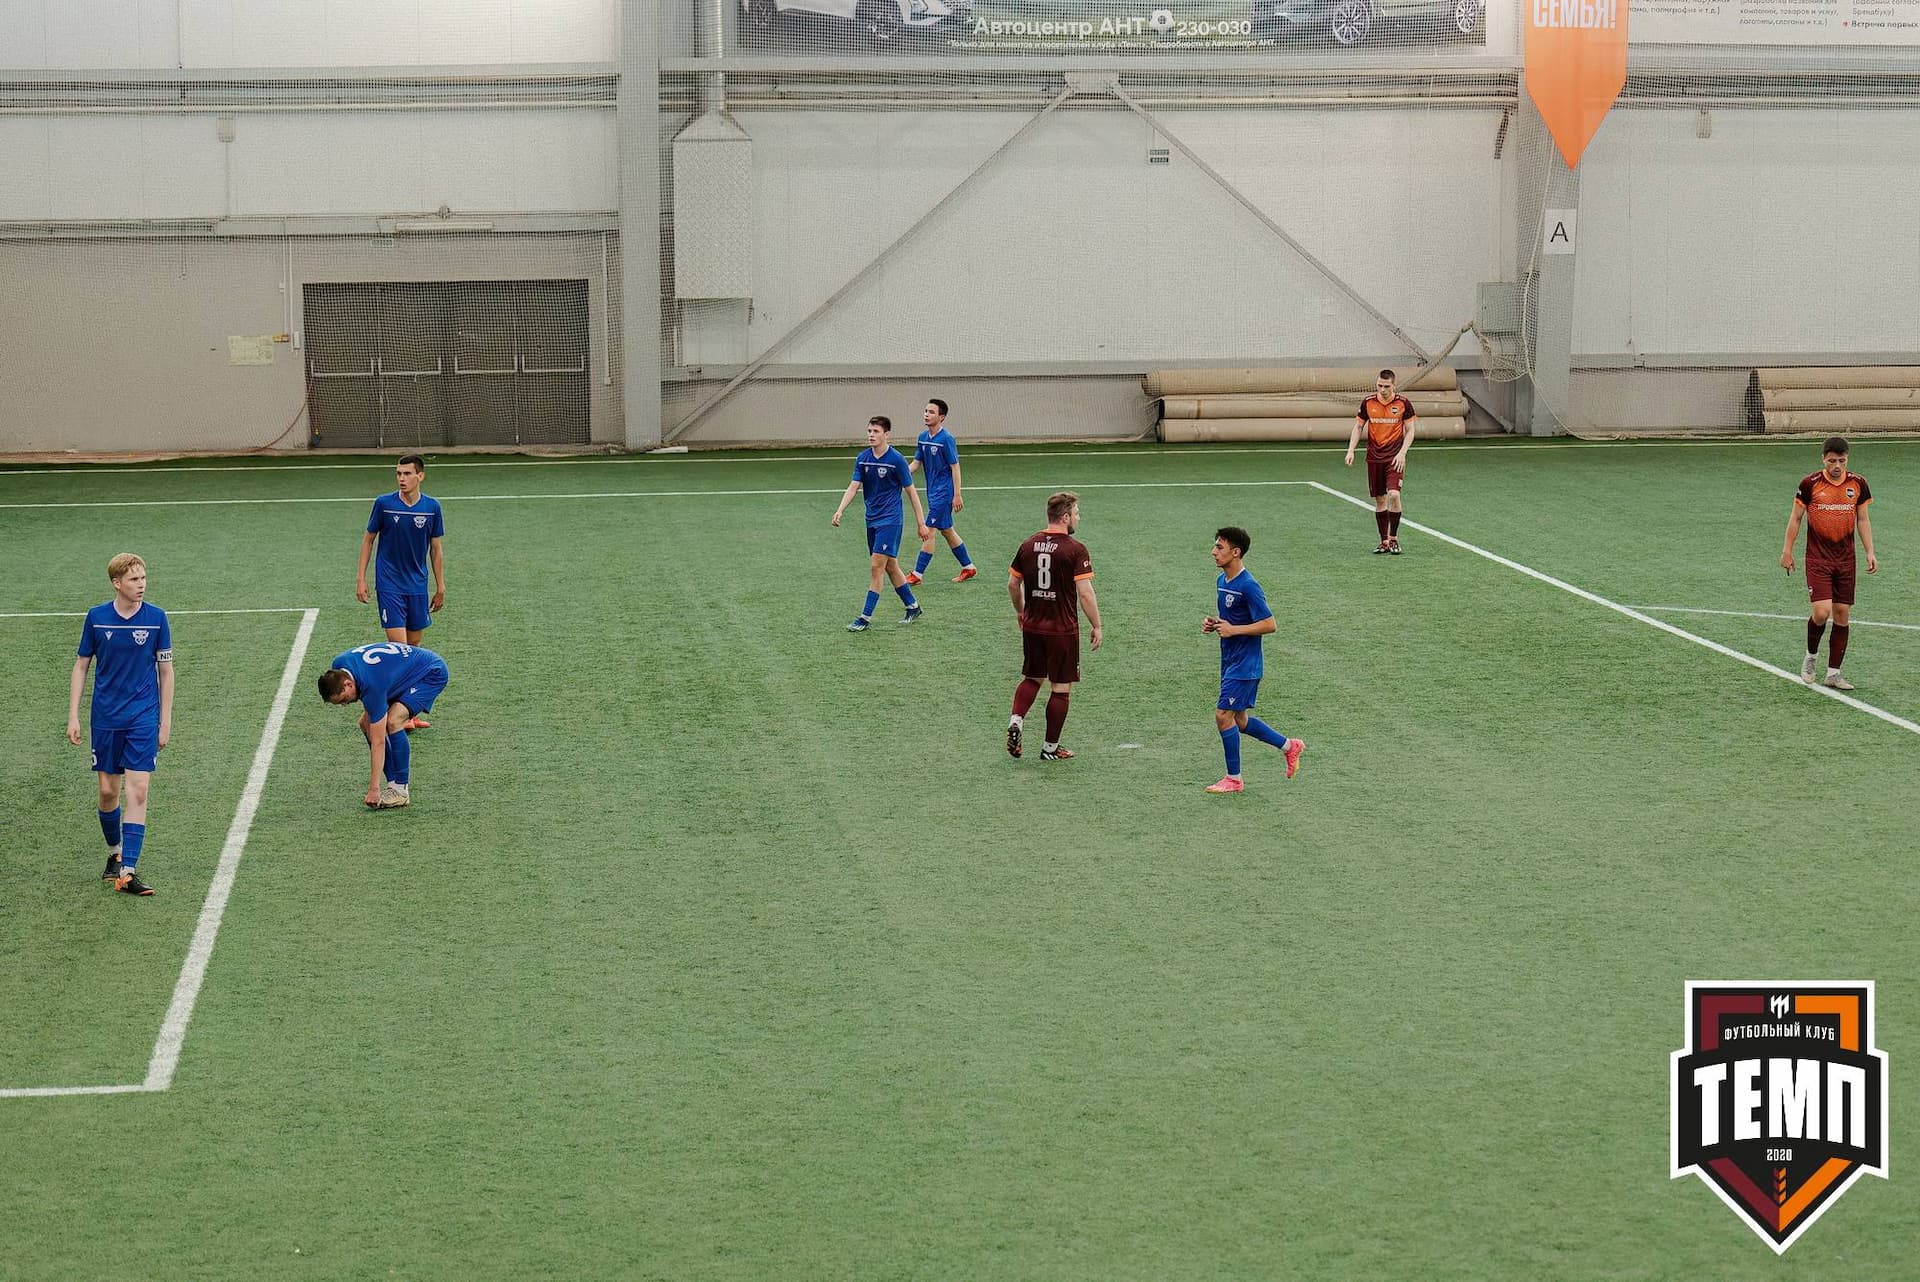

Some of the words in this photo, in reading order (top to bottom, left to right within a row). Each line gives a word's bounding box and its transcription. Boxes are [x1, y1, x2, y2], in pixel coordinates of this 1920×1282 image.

[1176, 20, 1252, 36] 230-030
[1533, 0, 1617, 28] СЕМЬЯ!
[1037, 552, 1051, 590] 8
